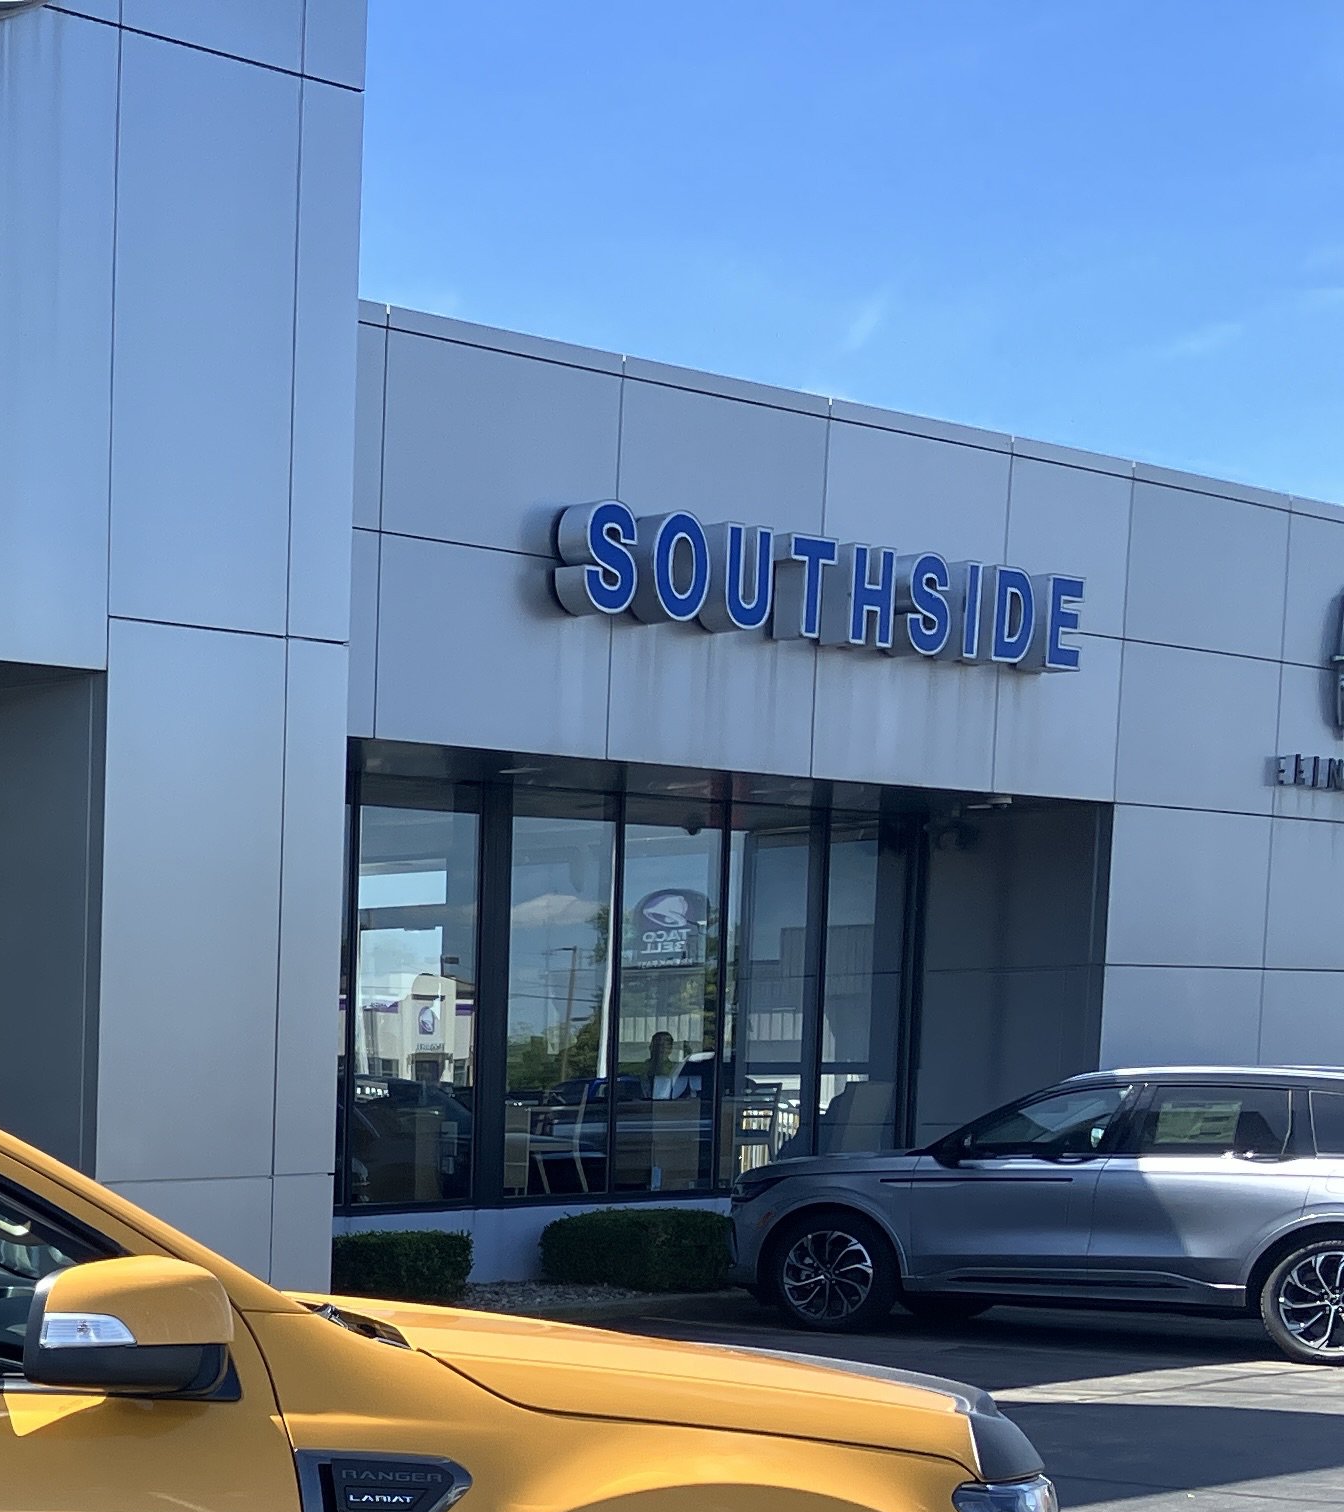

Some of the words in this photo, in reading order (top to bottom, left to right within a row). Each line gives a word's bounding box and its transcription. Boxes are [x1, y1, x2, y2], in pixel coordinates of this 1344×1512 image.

[556, 499, 1087, 673] SOUTHSIDE
[341, 1468, 443, 1484] RANGER
[349, 1494, 414, 1503] LARIAT
